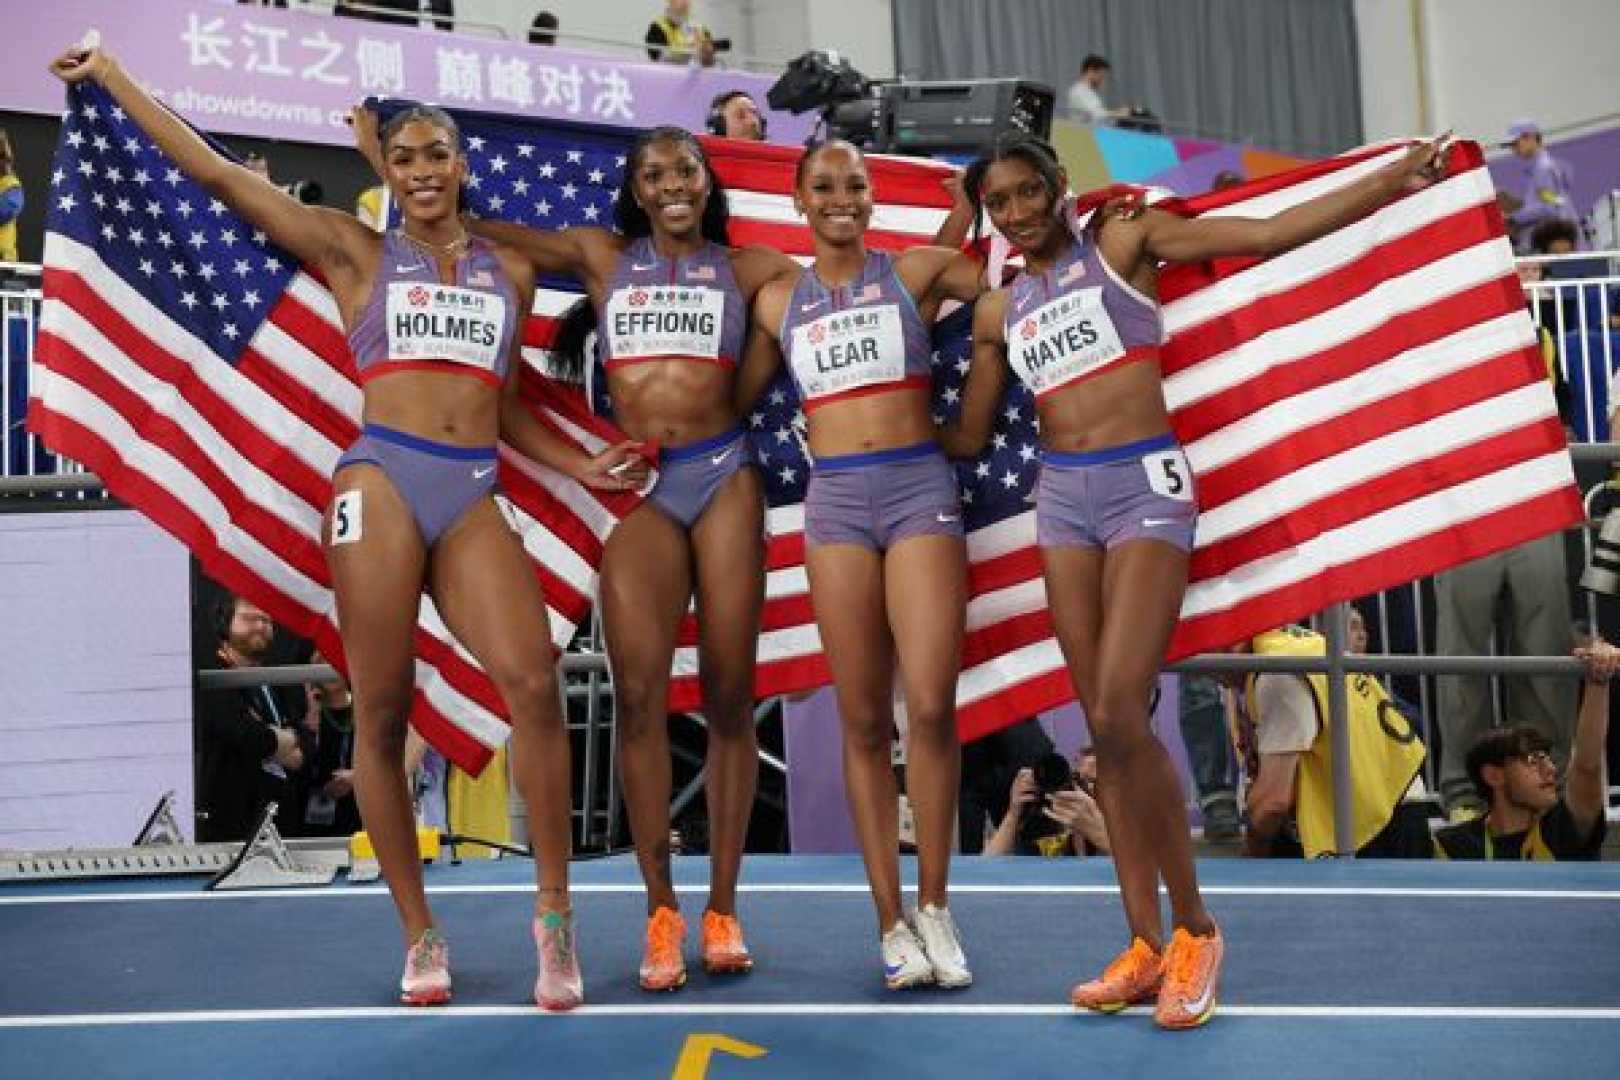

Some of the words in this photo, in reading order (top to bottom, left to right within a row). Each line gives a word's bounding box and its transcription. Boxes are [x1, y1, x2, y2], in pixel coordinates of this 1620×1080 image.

[396, 312, 497, 346] HOLMES
[615, 311, 714, 336] EFFIONG
[815, 337, 879, 373] LEAR
[1022, 319, 1099, 373] HAYES
[1161, 458, 1184, 494] 5
[337, 500, 349, 537] 5
